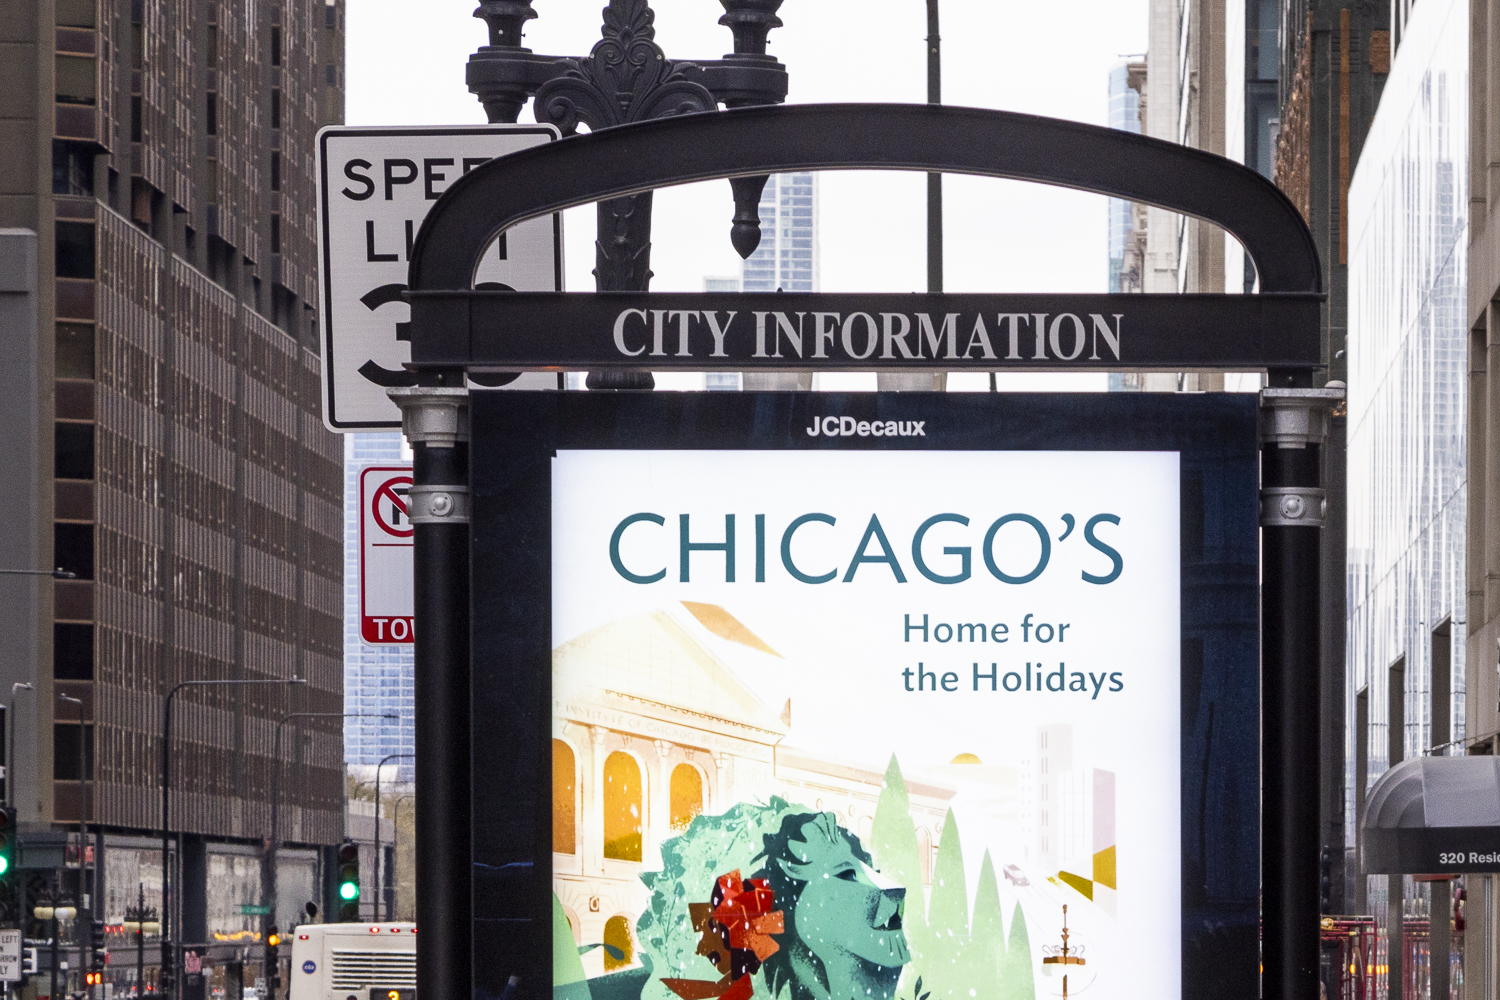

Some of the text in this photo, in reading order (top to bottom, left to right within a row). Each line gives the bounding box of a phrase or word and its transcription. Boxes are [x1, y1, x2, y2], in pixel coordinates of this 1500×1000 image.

[612, 307, 1124, 362] CITY INFORMATION
[806, 415, 926, 437] JCDecaux
[608, 511, 1124, 585] CHICAGO’S
[902, 613, 1071, 644] Home for
[901, 662, 1124, 700] the Holidays
[1439, 852, 1465, 864] 320
